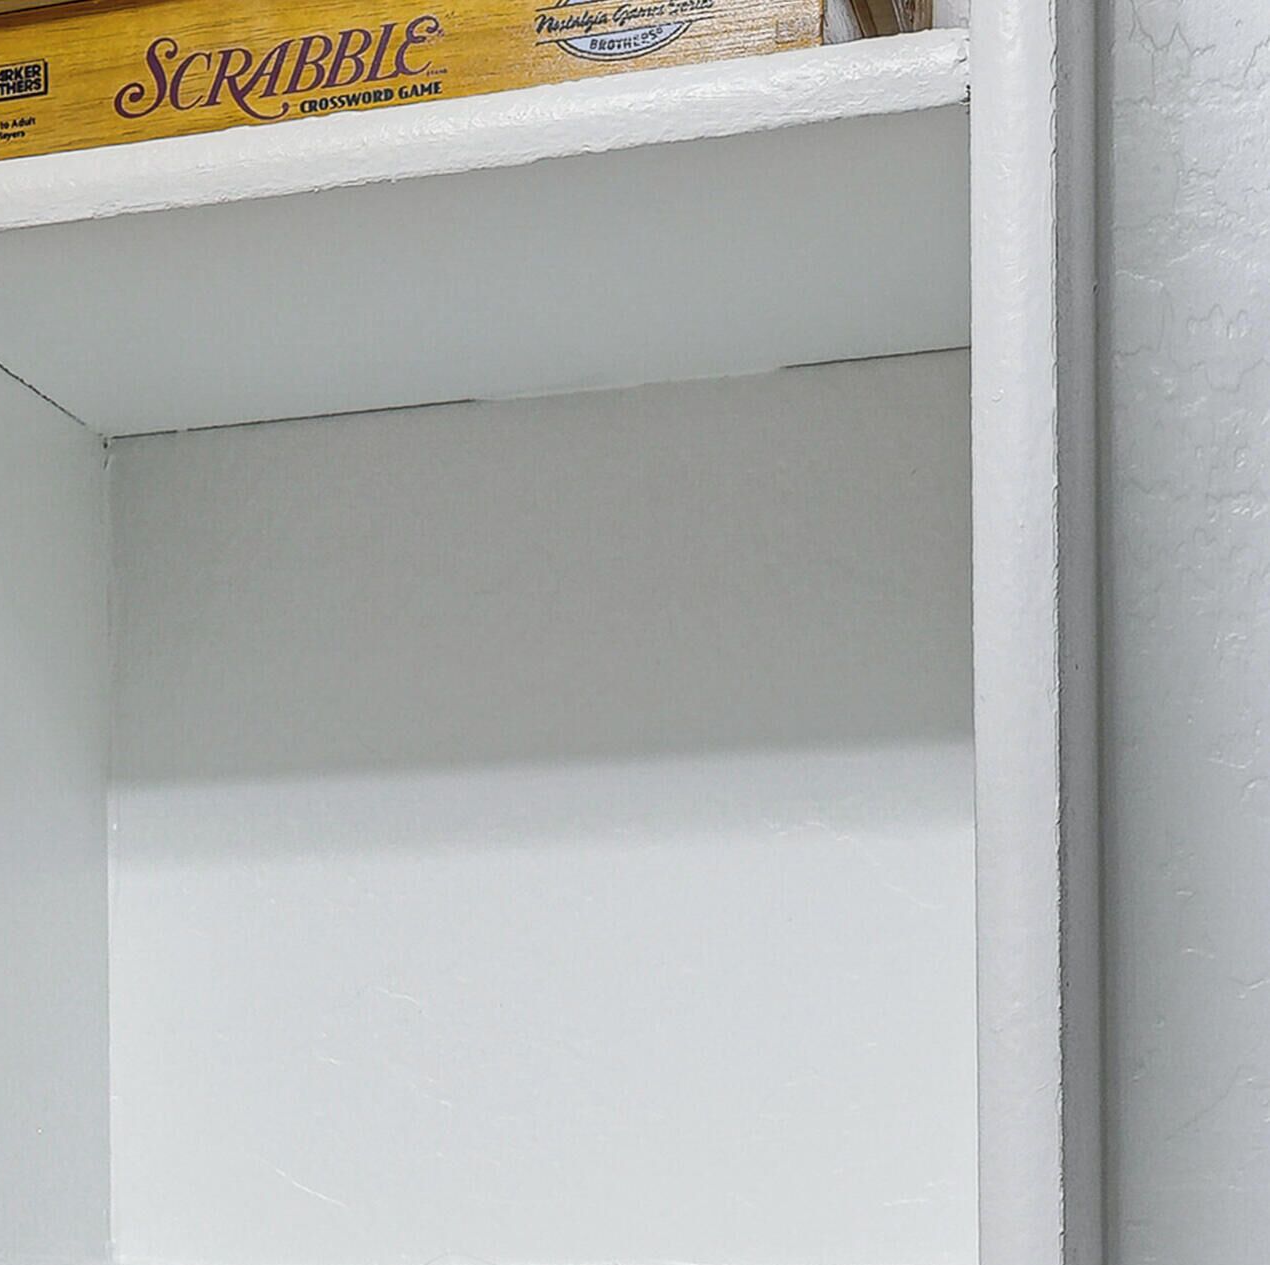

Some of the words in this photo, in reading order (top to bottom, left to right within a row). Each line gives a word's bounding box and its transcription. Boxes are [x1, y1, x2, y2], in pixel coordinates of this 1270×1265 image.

[535, 10, 608, 34] Nostalgia
[612, 4, 665, 25] Games
[114, 15, 440, 121] SCRABBLE
[300, 87, 394, 113] CROSSWORD
[398, 81, 442, 99] GAME
[0, 121, 10, 130] to
[11, 116, 36, 128] Adult
